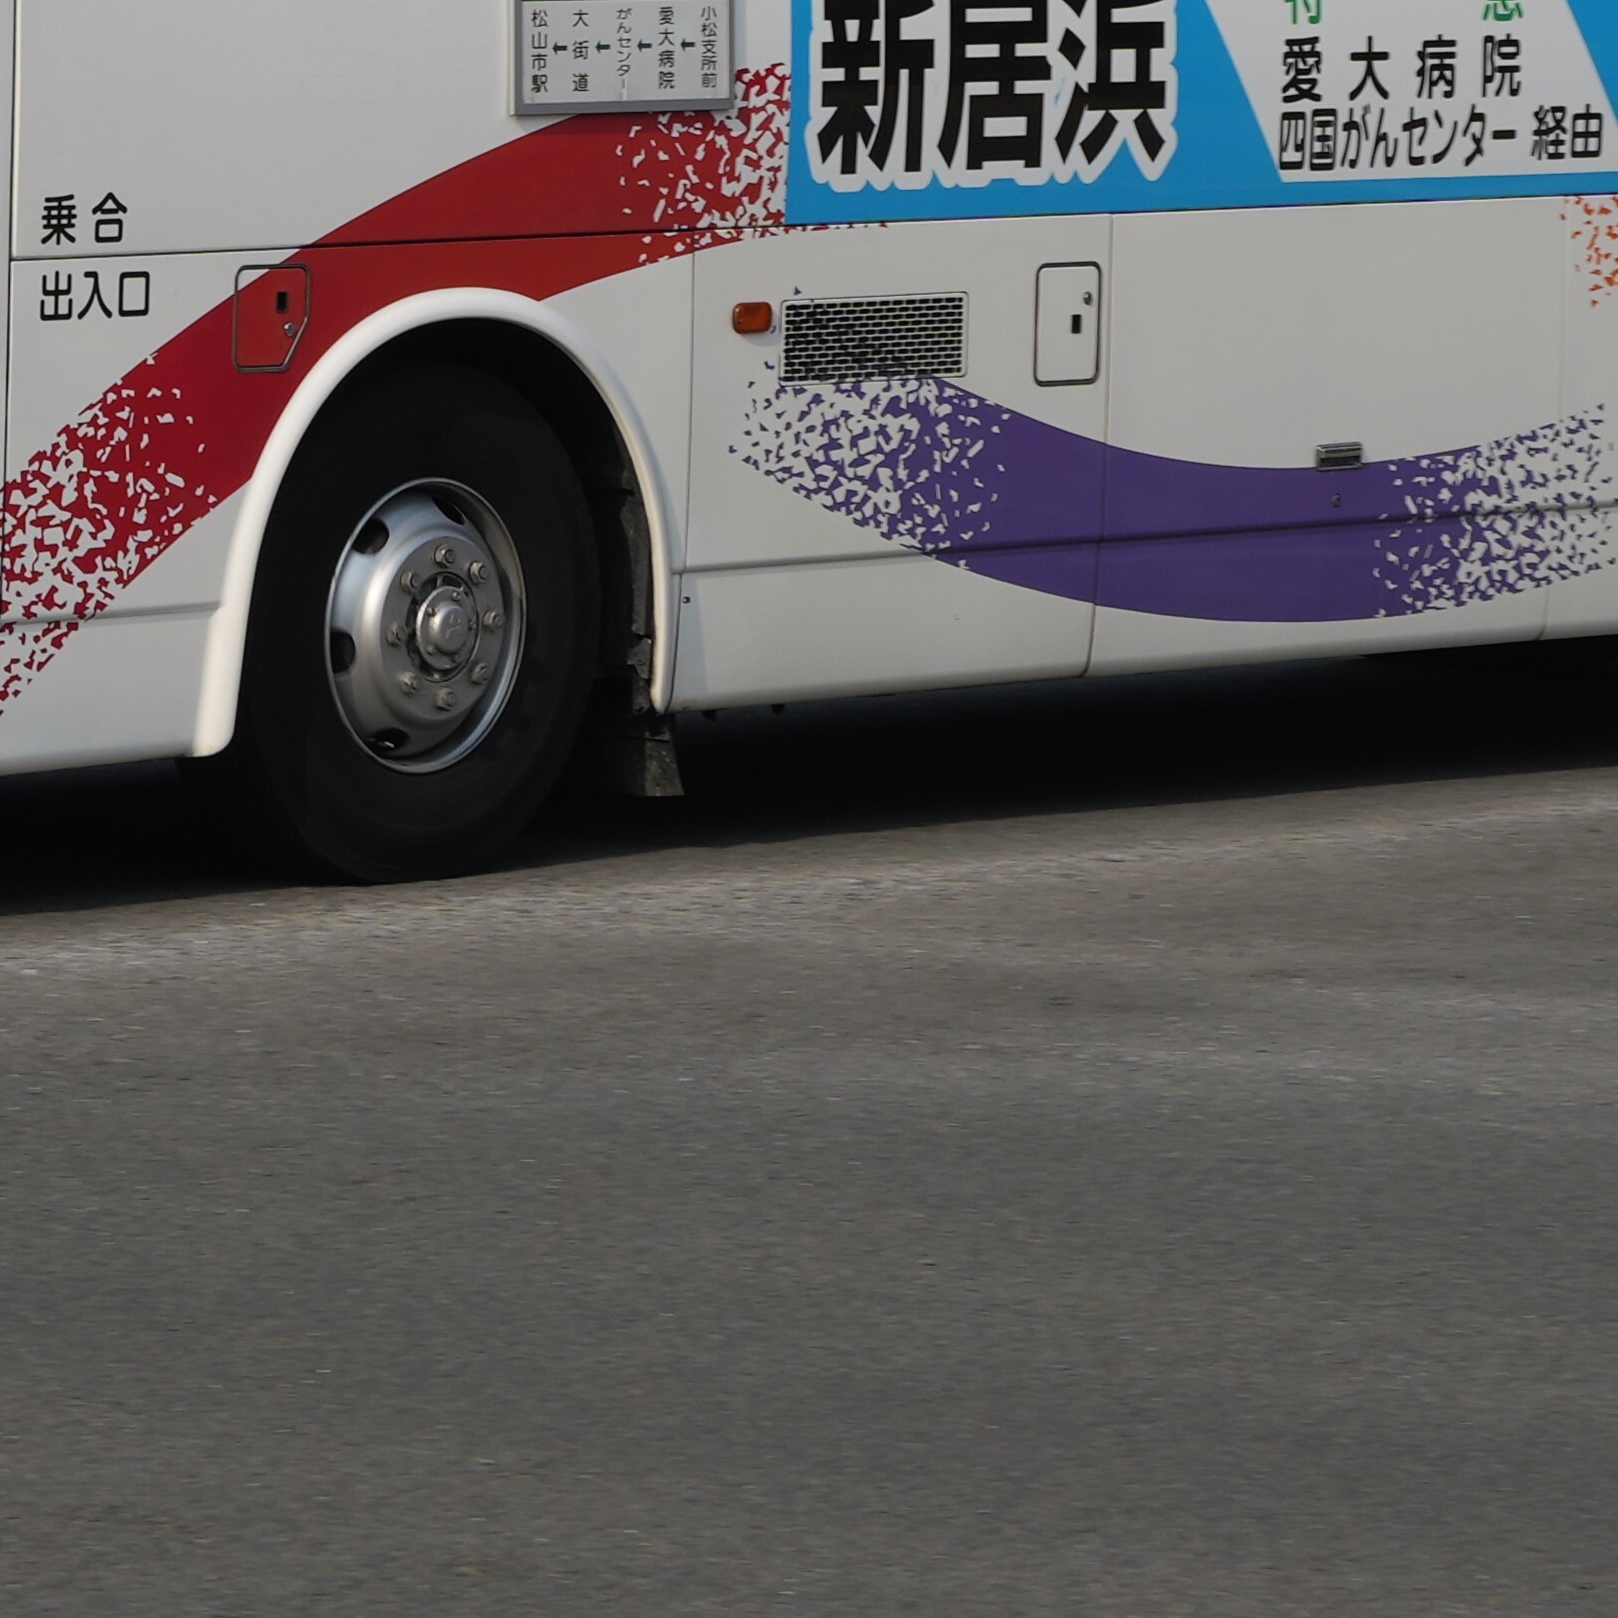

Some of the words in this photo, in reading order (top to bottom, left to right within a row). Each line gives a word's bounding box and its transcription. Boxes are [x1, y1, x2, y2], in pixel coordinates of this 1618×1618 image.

[531, 9, 549, 94] 松山市駅
[572, 8, 590, 93] 大街道
[615, 7, 633, 90] がんセンター
[658, 5, 676, 90] 愛大病院
[700, 5, 718, 89] 小松支所前
[1281, 33, 1522, 103] 愛大病院
[40, 192, 128, 246] 乗合
[39, 269, 150, 322] 出入口
